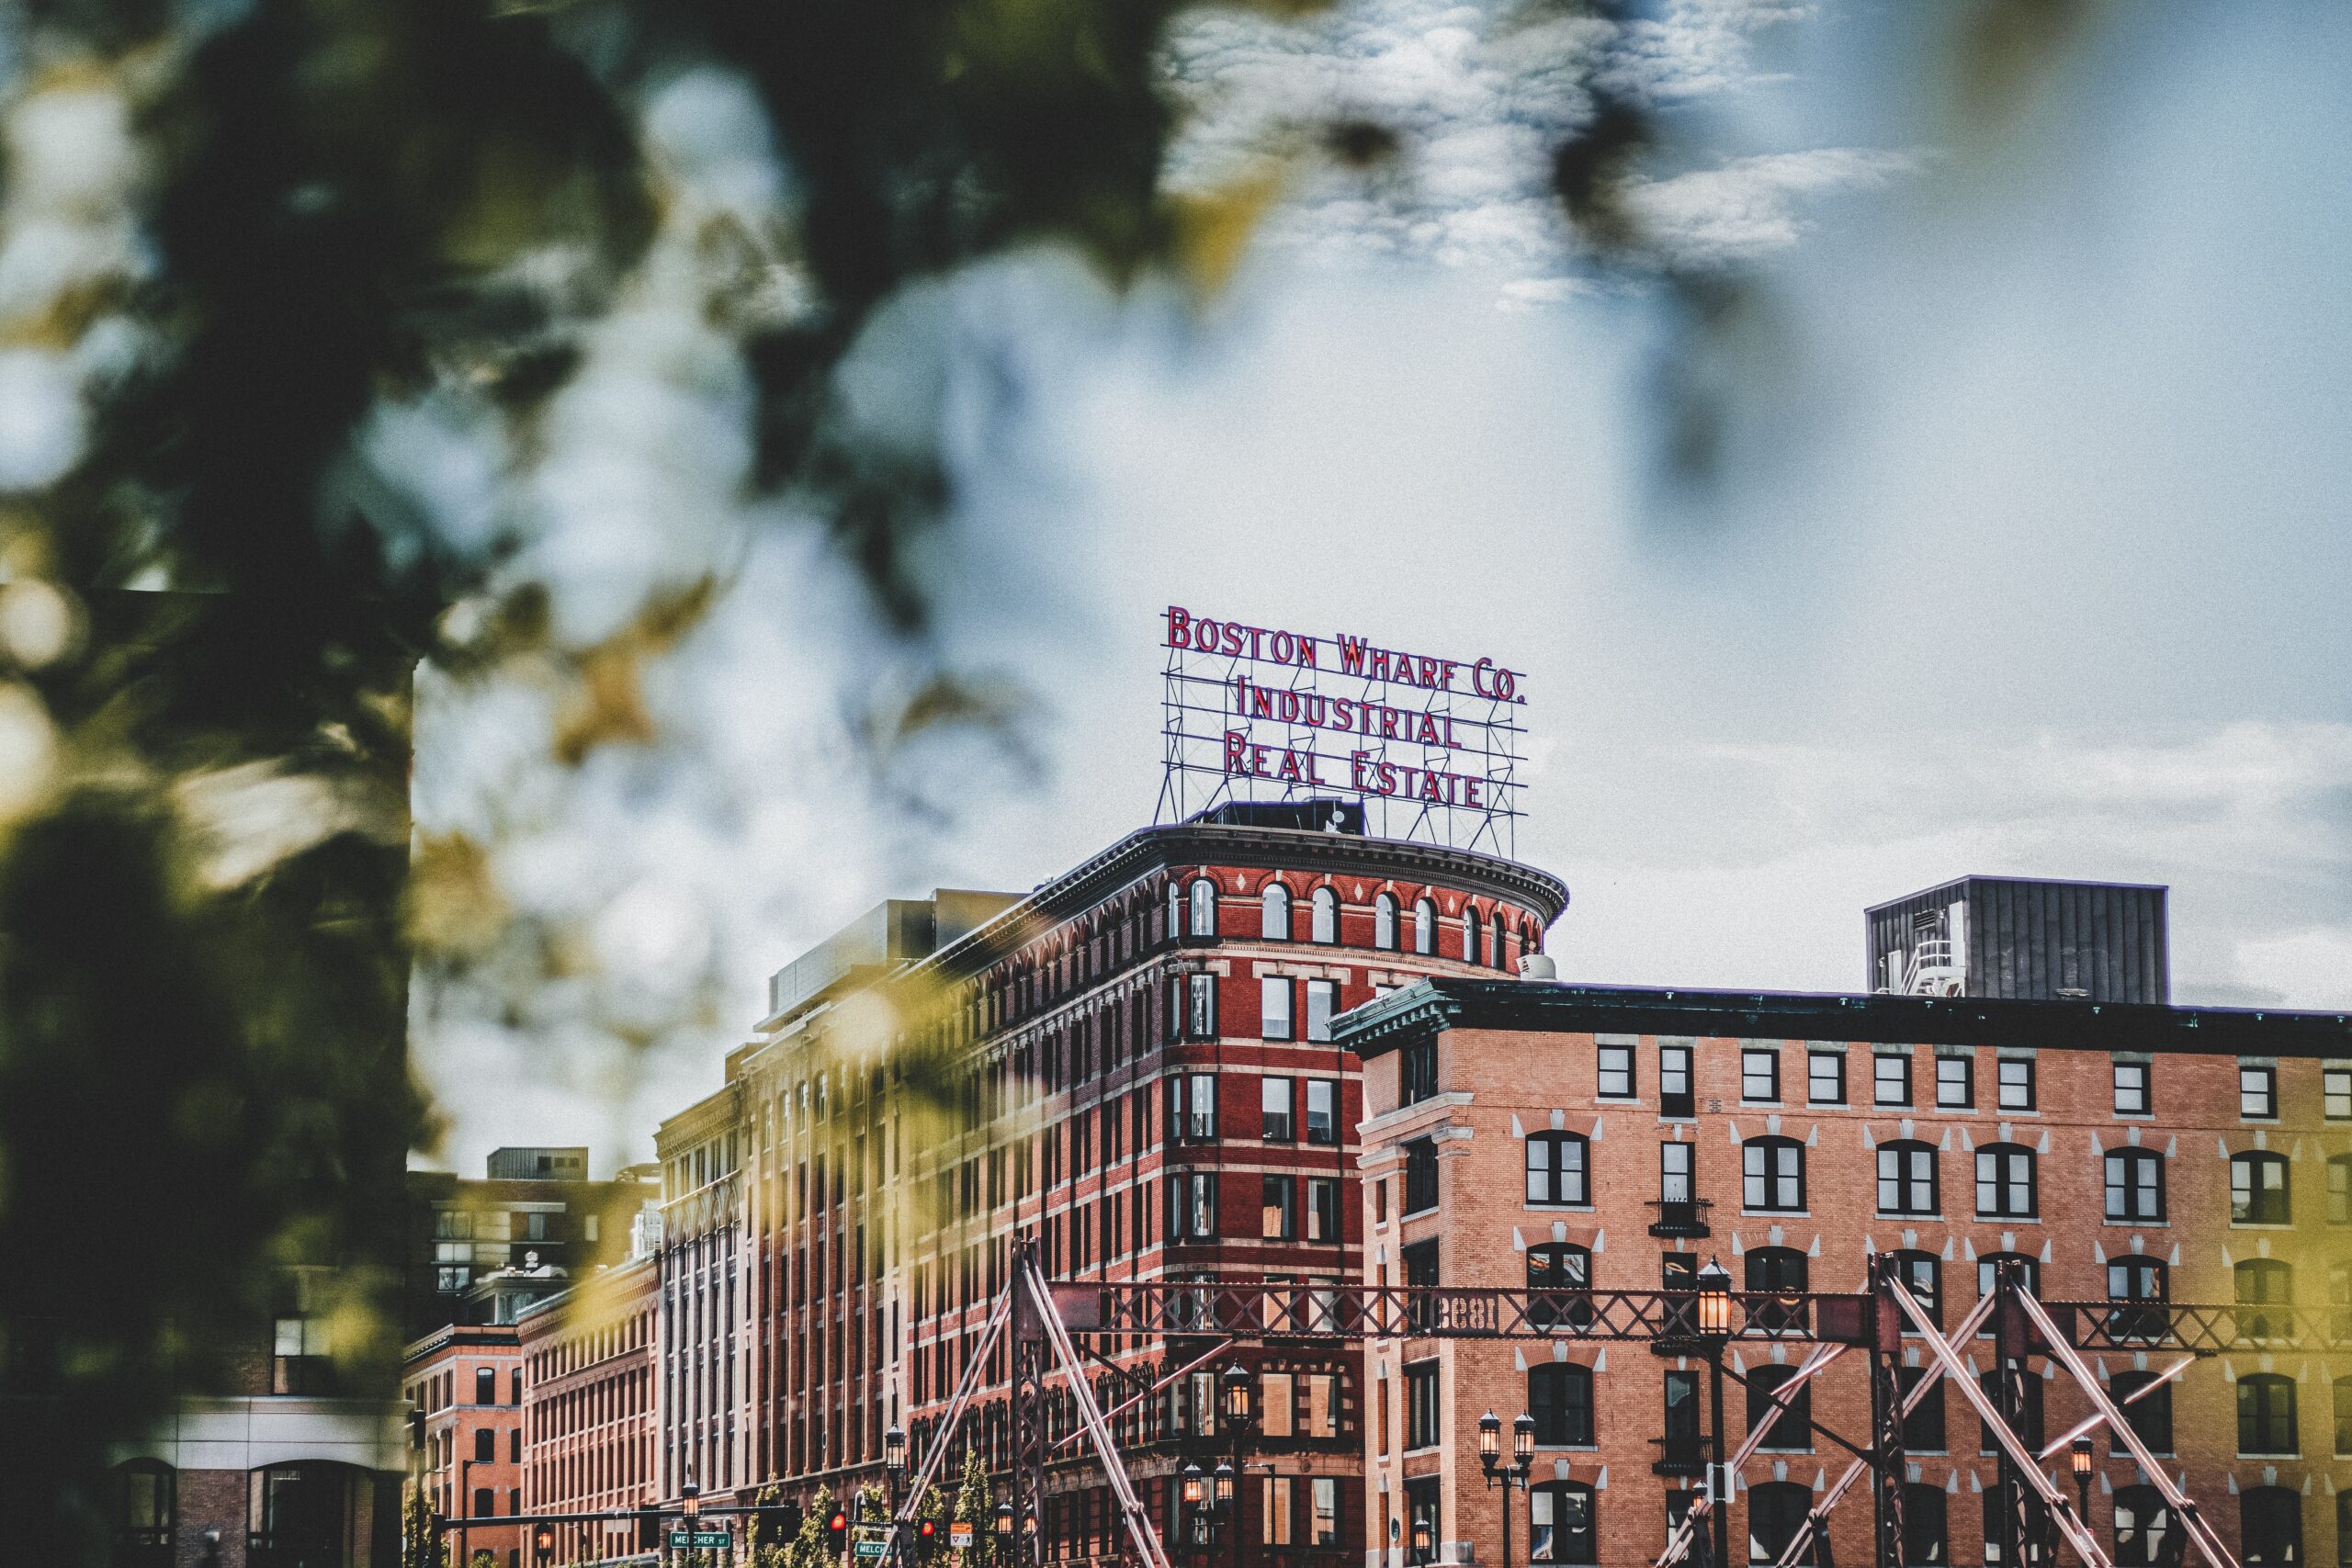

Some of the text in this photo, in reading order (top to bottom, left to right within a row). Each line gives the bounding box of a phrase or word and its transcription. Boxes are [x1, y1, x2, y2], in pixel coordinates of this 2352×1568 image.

[1168, 605, 1525, 704] BOSTON WHARF CO.
[1237, 674, 1462, 750] INDUSTRIAL
[1224, 731, 1484, 808] REAL ESTATE
